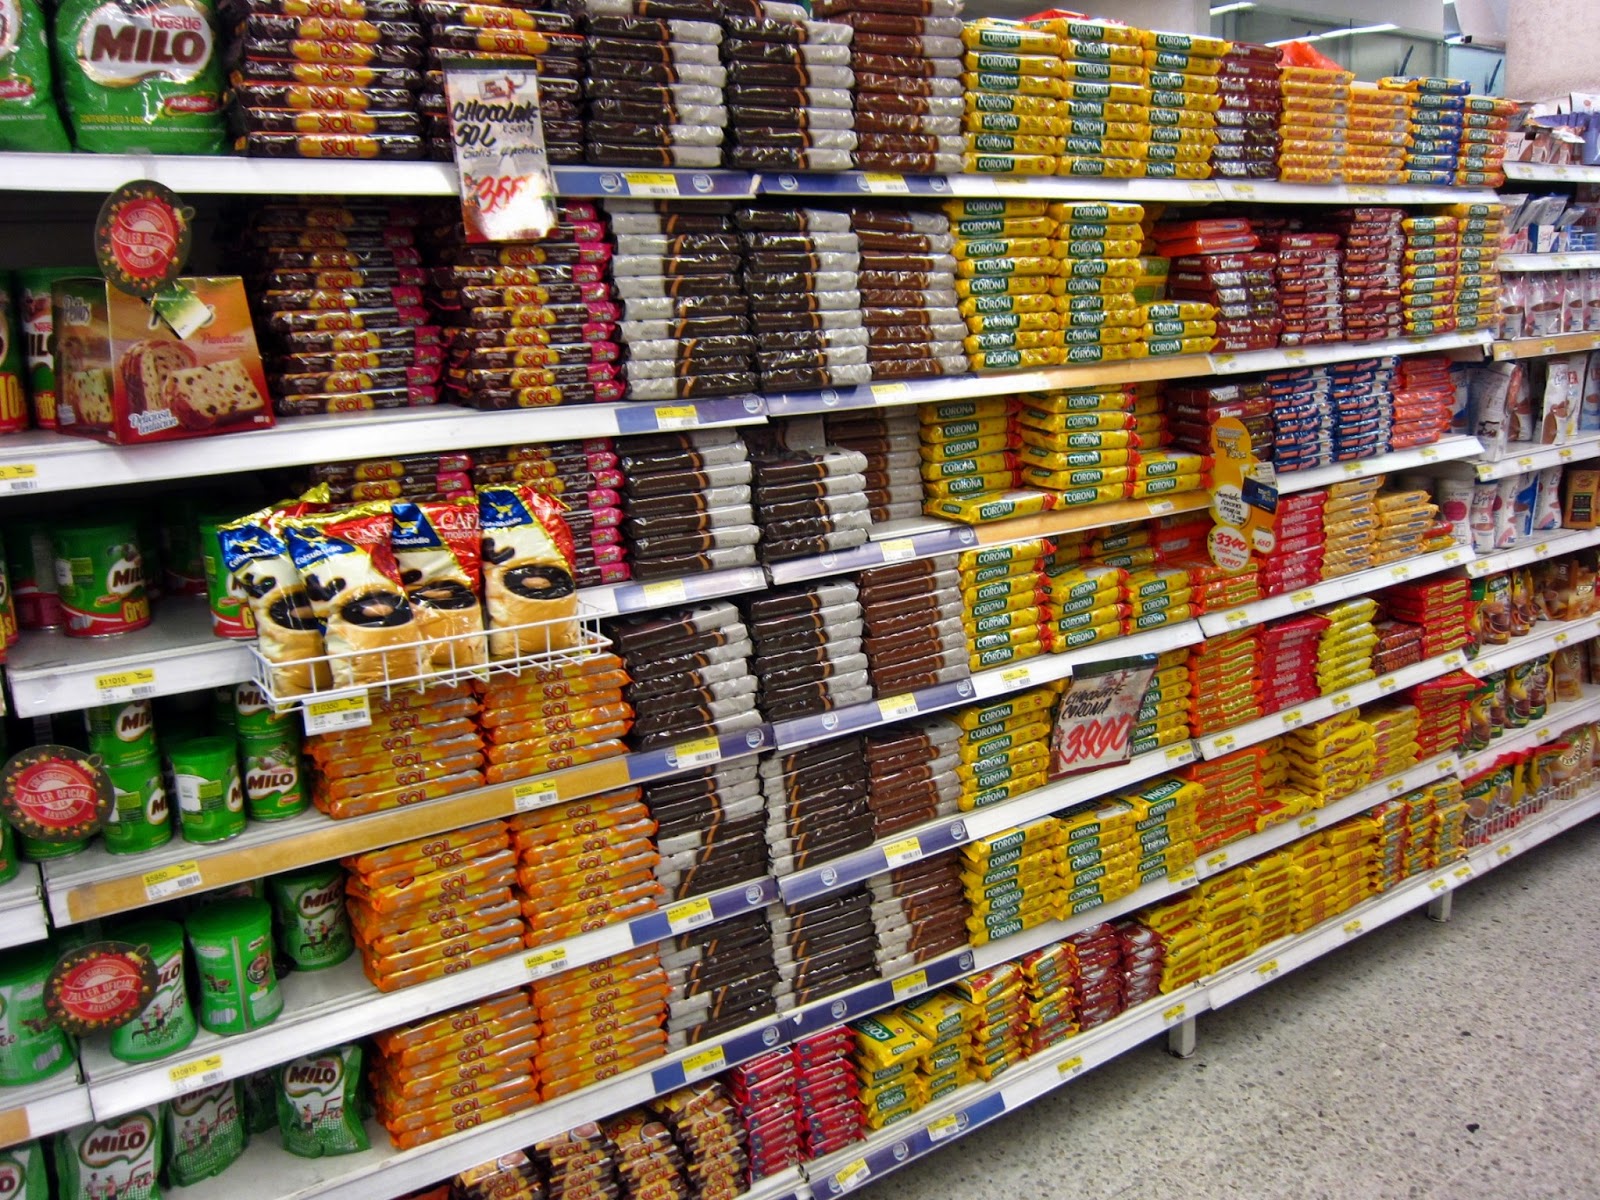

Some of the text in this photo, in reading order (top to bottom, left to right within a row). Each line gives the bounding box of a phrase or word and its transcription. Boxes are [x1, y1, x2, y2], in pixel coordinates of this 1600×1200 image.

[483, 10, 517, 31] SOL
[494, 34, 529, 51] SOL
[982, 31, 1020, 44] CORONA
[92, 25, 206, 65] MILO
[980, 56, 1017, 68] CORONA
[980, 75, 1017, 87] CORONA
[977, 97, 1013, 109] CORONA
[984, 117, 1017, 129] CORONA
[978, 136, 1012, 150] CORONA
[979, 158, 1012, 169] CORONA
[961, 222, 1001, 232] CORONA
[341, 336, 369, 350] SOL
[341, 355, 369, 368] SOL
[522, 353, 549, 365] SOL
[333, 378, 361, 390] SOL
[519, 371, 547, 384] SOL
[526, 391, 554, 404] SOL
[1069, 397, 1098, 409] CORONA
[335, 399, 363, 411] SOL
[940, 405, 974, 418] CORONA
[1067, 417, 1096, 428] CORONA
[945, 424, 977, 437] CORONA
[1070, 434, 1099, 447] CORONA
[946, 441, 977, 456] CORONA
[1069, 452, 1099, 464] CORONA
[361, 466, 392, 479] SOL
[943, 461, 975, 474] CORONA
[1148, 463, 1175, 474] CORONA
[950, 477, 982, 491] CORONA
[1072, 472, 1101, 484] CORONA
[1148, 479, 1175, 491] CORONA
[361, 484, 392, 498] SOL
[1067, 490, 1096, 504] CORONA
[982, 503, 1012, 518] CORONA
[979, 551, 1011, 564] CORONA
[978, 567, 1007, 580] CORONA
[979, 583, 1010, 597] CORONA
[975, 601, 1005, 615] CORONA
[978, 616, 1009, 629] CORONA
[977, 634, 1008, 647] CORONA
[982, 650, 1012, 664] CORONA
[980, 706, 1010, 722] CORONA
[1061, 698, 1112, 720] CORONA
[970, 724, 1003, 738] CORONA
[980, 738, 1010, 754] CORONA
[975, 755, 1007, 771] CORONA
[248, 774, 293, 789] MILO
[979, 770, 1010, 786] CORONA
[57, 789, 90, 799] OFICIAL
[976, 790, 1006, 805] CORONA
[1071, 825, 1098, 839] CORONA
[993, 833, 1023, 850] CORONA
[1069, 840, 1097, 854] CORONA
[990, 850, 1019, 866] CORONA
[985, 866, 1017, 883] CORONA
[986, 881, 1016, 897] CORONA
[992, 890, 1023, 908] CORONA
[991, 922, 1021, 939] CORONA
[589, 975, 614, 989] SOL
[596, 989, 620, 1003] SOL
[591, 1003, 616, 1020] SOL
[452, 1012, 480, 1032] SOL
[596, 1019, 619, 1034] SOL
[462, 1028, 492, 1046] SOL
[590, 1036, 614, 1050] SOL
[457, 1046, 486, 1063] SOL
[595, 1051, 619, 1065] SOL
[289, 1065, 335, 1084] MILO
[459, 1064, 488, 1079] SOL
[595, 1066, 619, 1079] SOL
[451, 1080, 477, 1097] SOL
[452, 1098, 481, 1115] SOL
[455, 1114, 482, 1131] SOL
[88, 1131, 146, 1156] MILO
